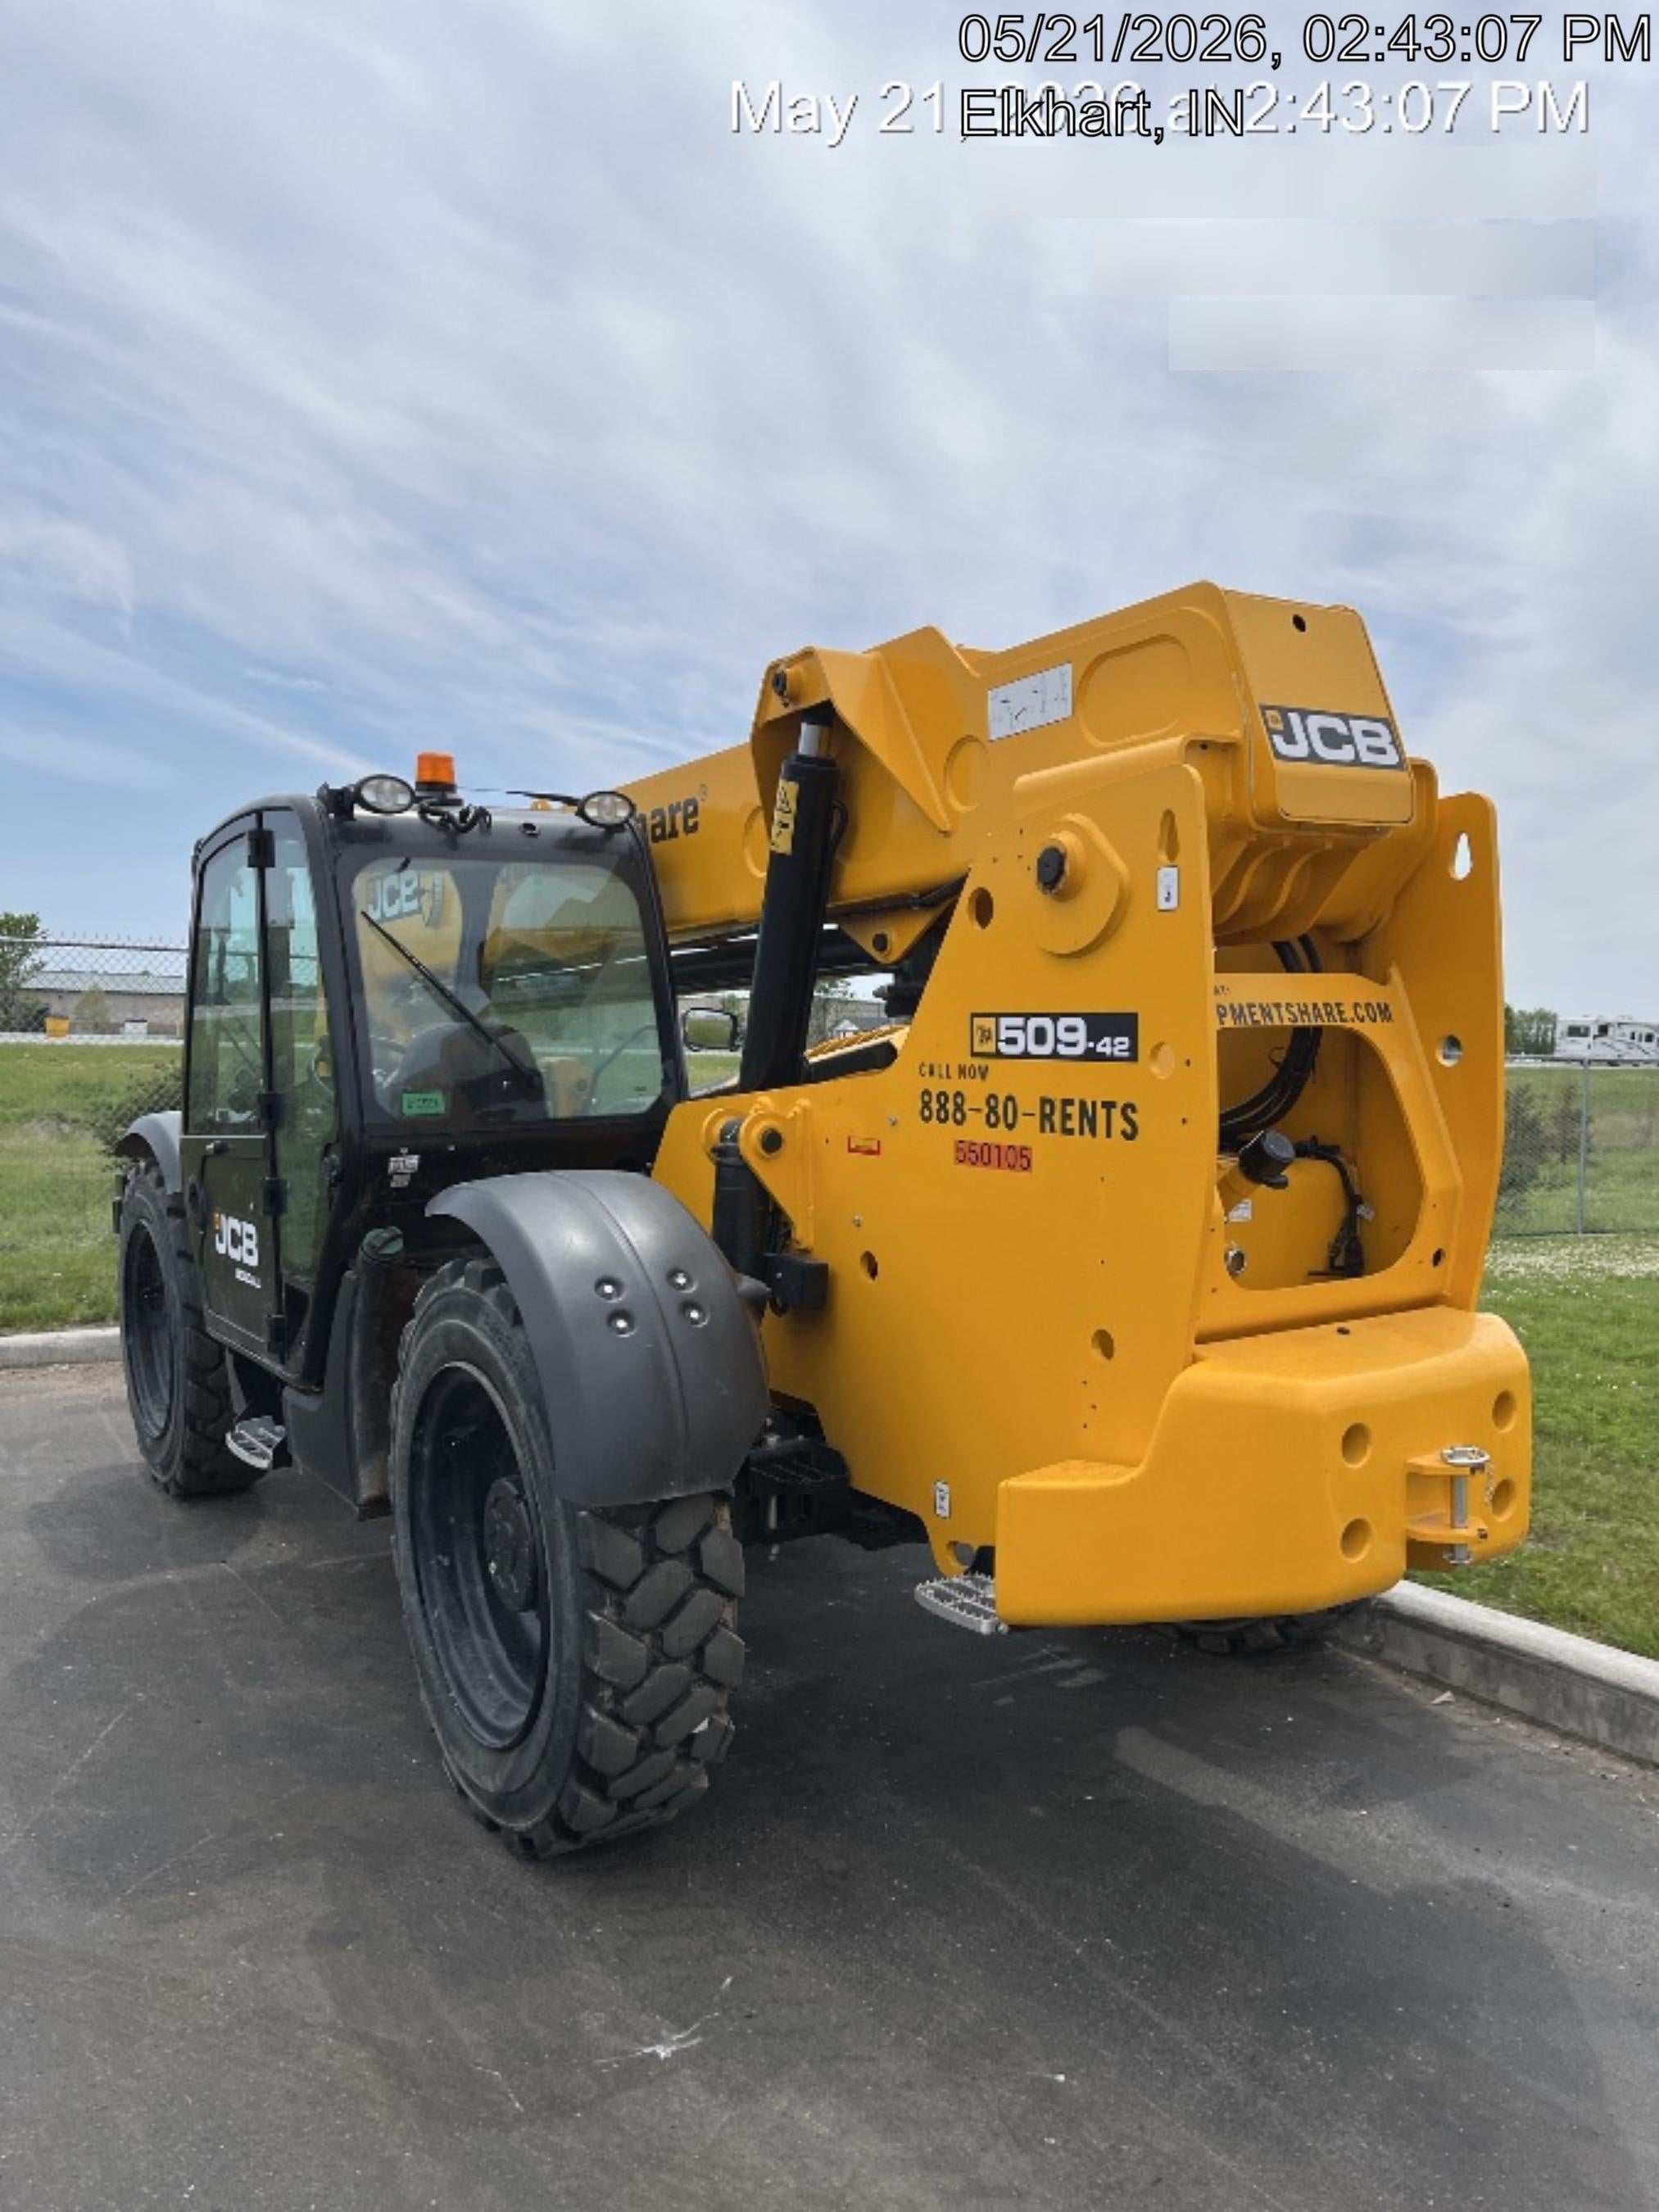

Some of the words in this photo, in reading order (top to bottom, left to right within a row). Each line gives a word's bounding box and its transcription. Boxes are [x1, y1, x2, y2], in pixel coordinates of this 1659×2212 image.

[1272, 712, 1399, 764] JCB
[957, 1064, 990, 1081] NOW
[919, 1088, 1139, 1141] 888-80-RENTS
[955, 1140, 1031, 1171] 550105
[215, 1213, 259, 1267] JCB
